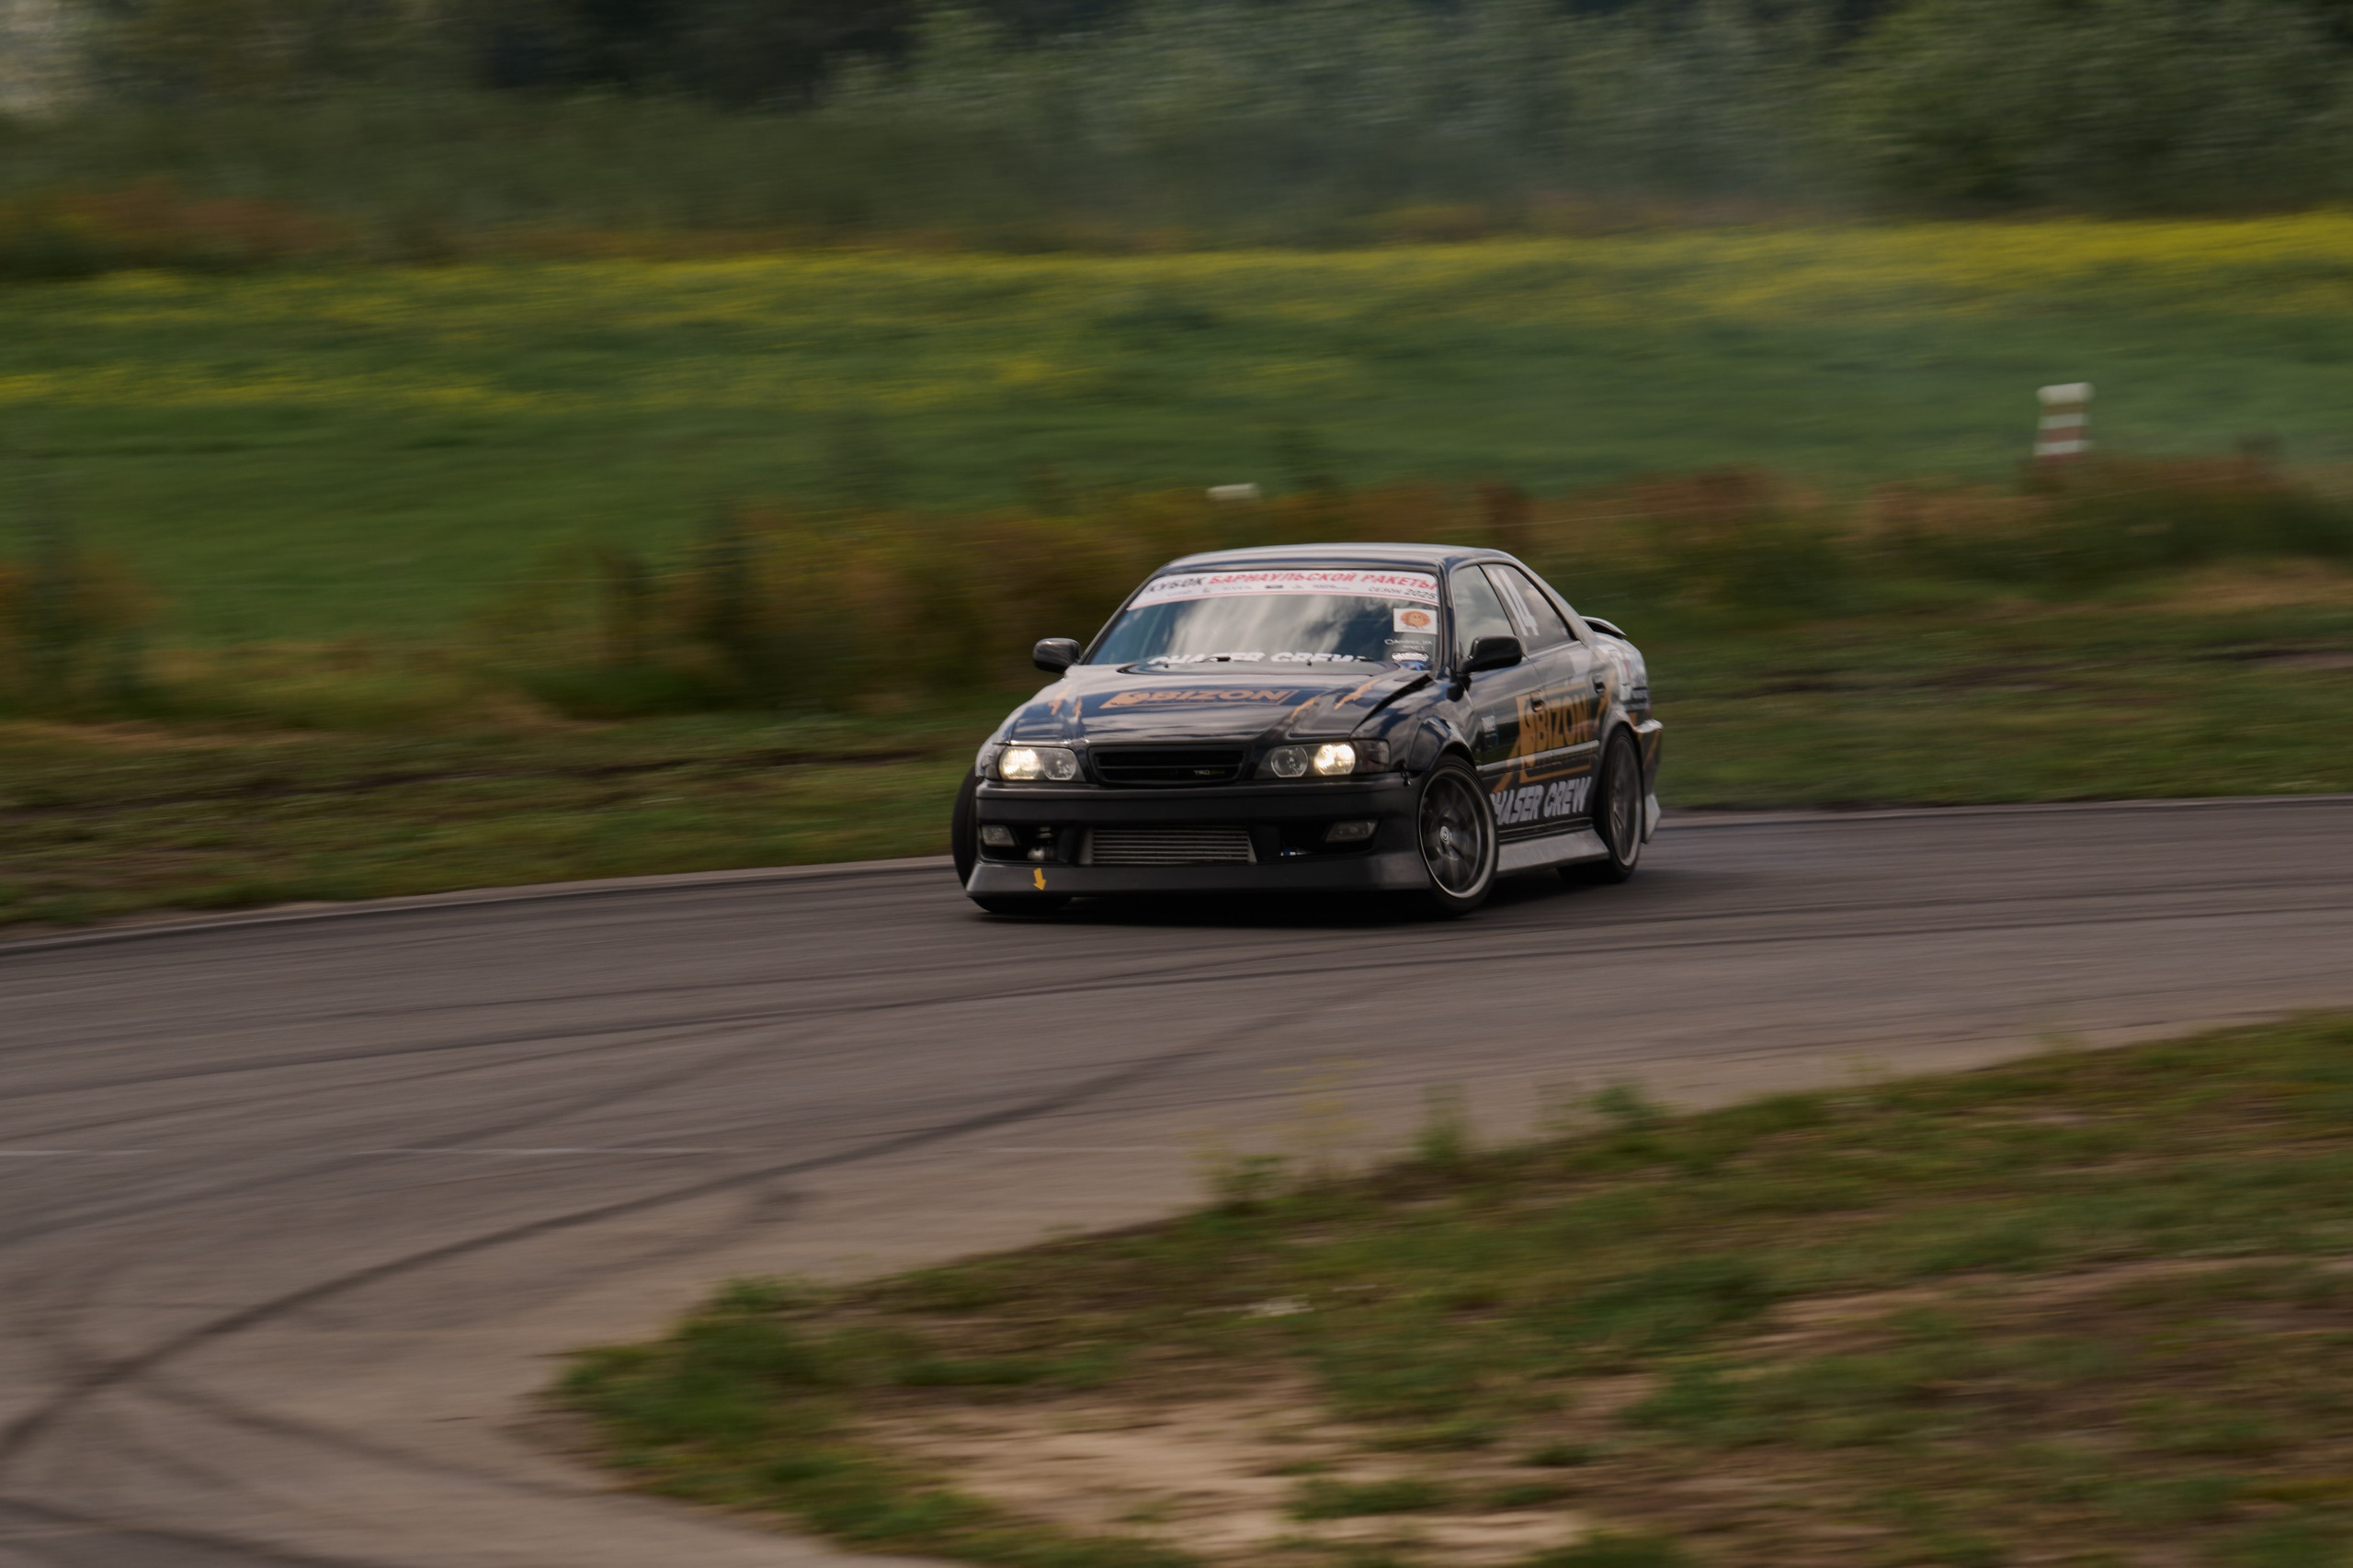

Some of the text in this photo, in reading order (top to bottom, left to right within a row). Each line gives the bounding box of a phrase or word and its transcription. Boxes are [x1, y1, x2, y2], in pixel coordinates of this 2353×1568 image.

[1148, 576, 1206, 593] КУБОК
[1208, 572, 1358, 585] БАРНАУЛЬСКОЙ
[1360, 574, 1438, 591] РАКЕТЫ
[1404, 587, 1437, 599] 2025
[1488, 569, 1540, 636] 14
[1148, 690, 1288, 701] BIZON
[1535, 692, 1590, 752] BIZON
[1490, 776, 1592, 825] HASER CREW
